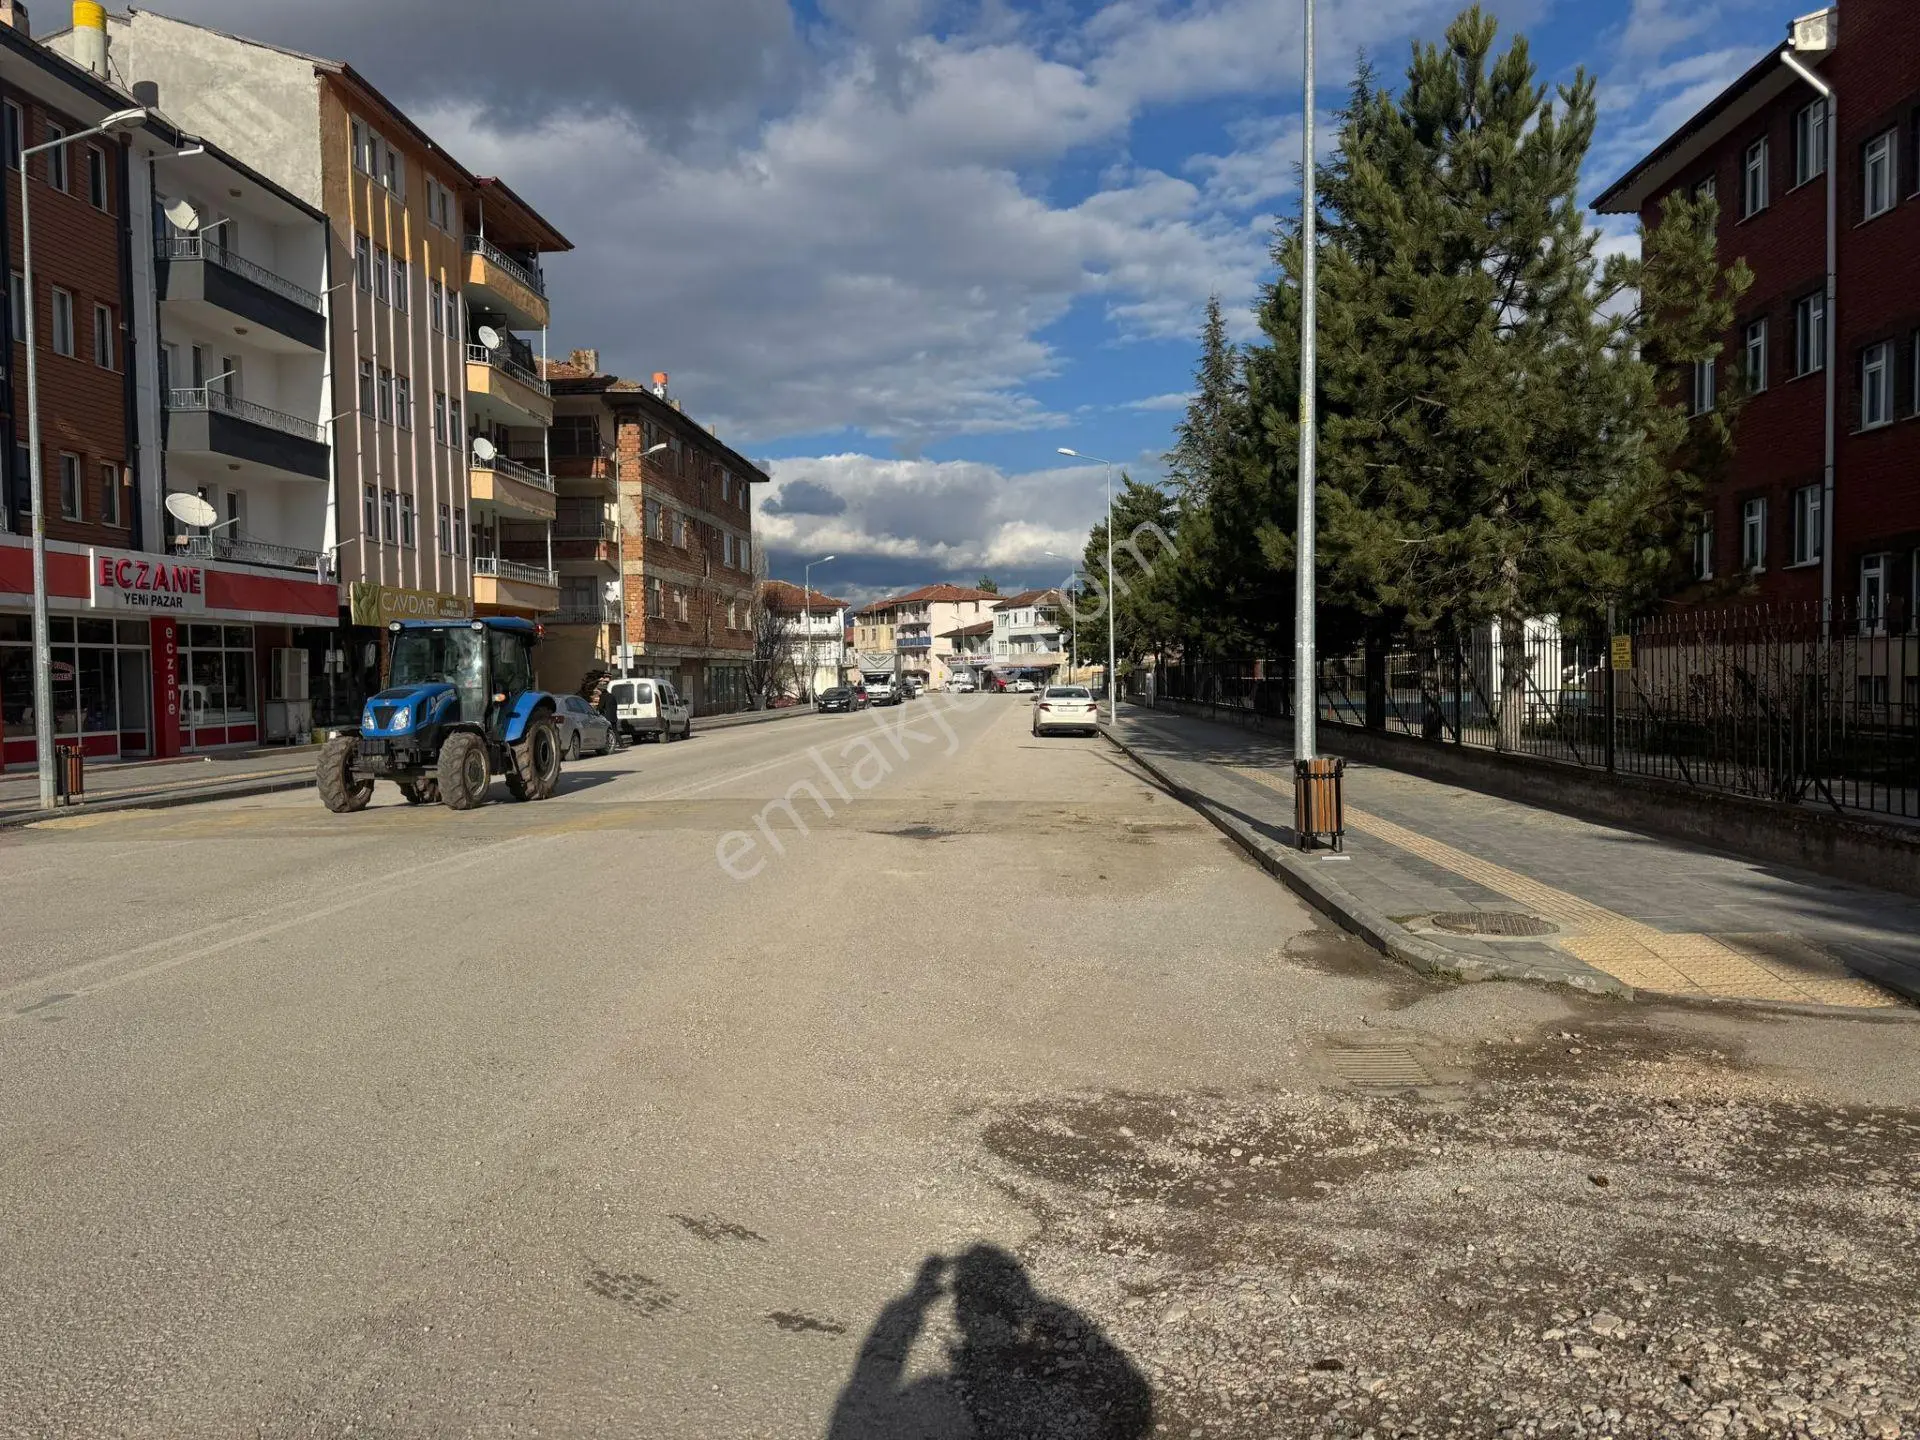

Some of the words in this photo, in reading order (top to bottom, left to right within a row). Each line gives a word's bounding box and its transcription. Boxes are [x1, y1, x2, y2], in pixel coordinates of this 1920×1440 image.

[98, 556, 202, 595] ECZANE
[151, 594, 183, 608] PAZAR
[165, 627, 176, 715] eczane
